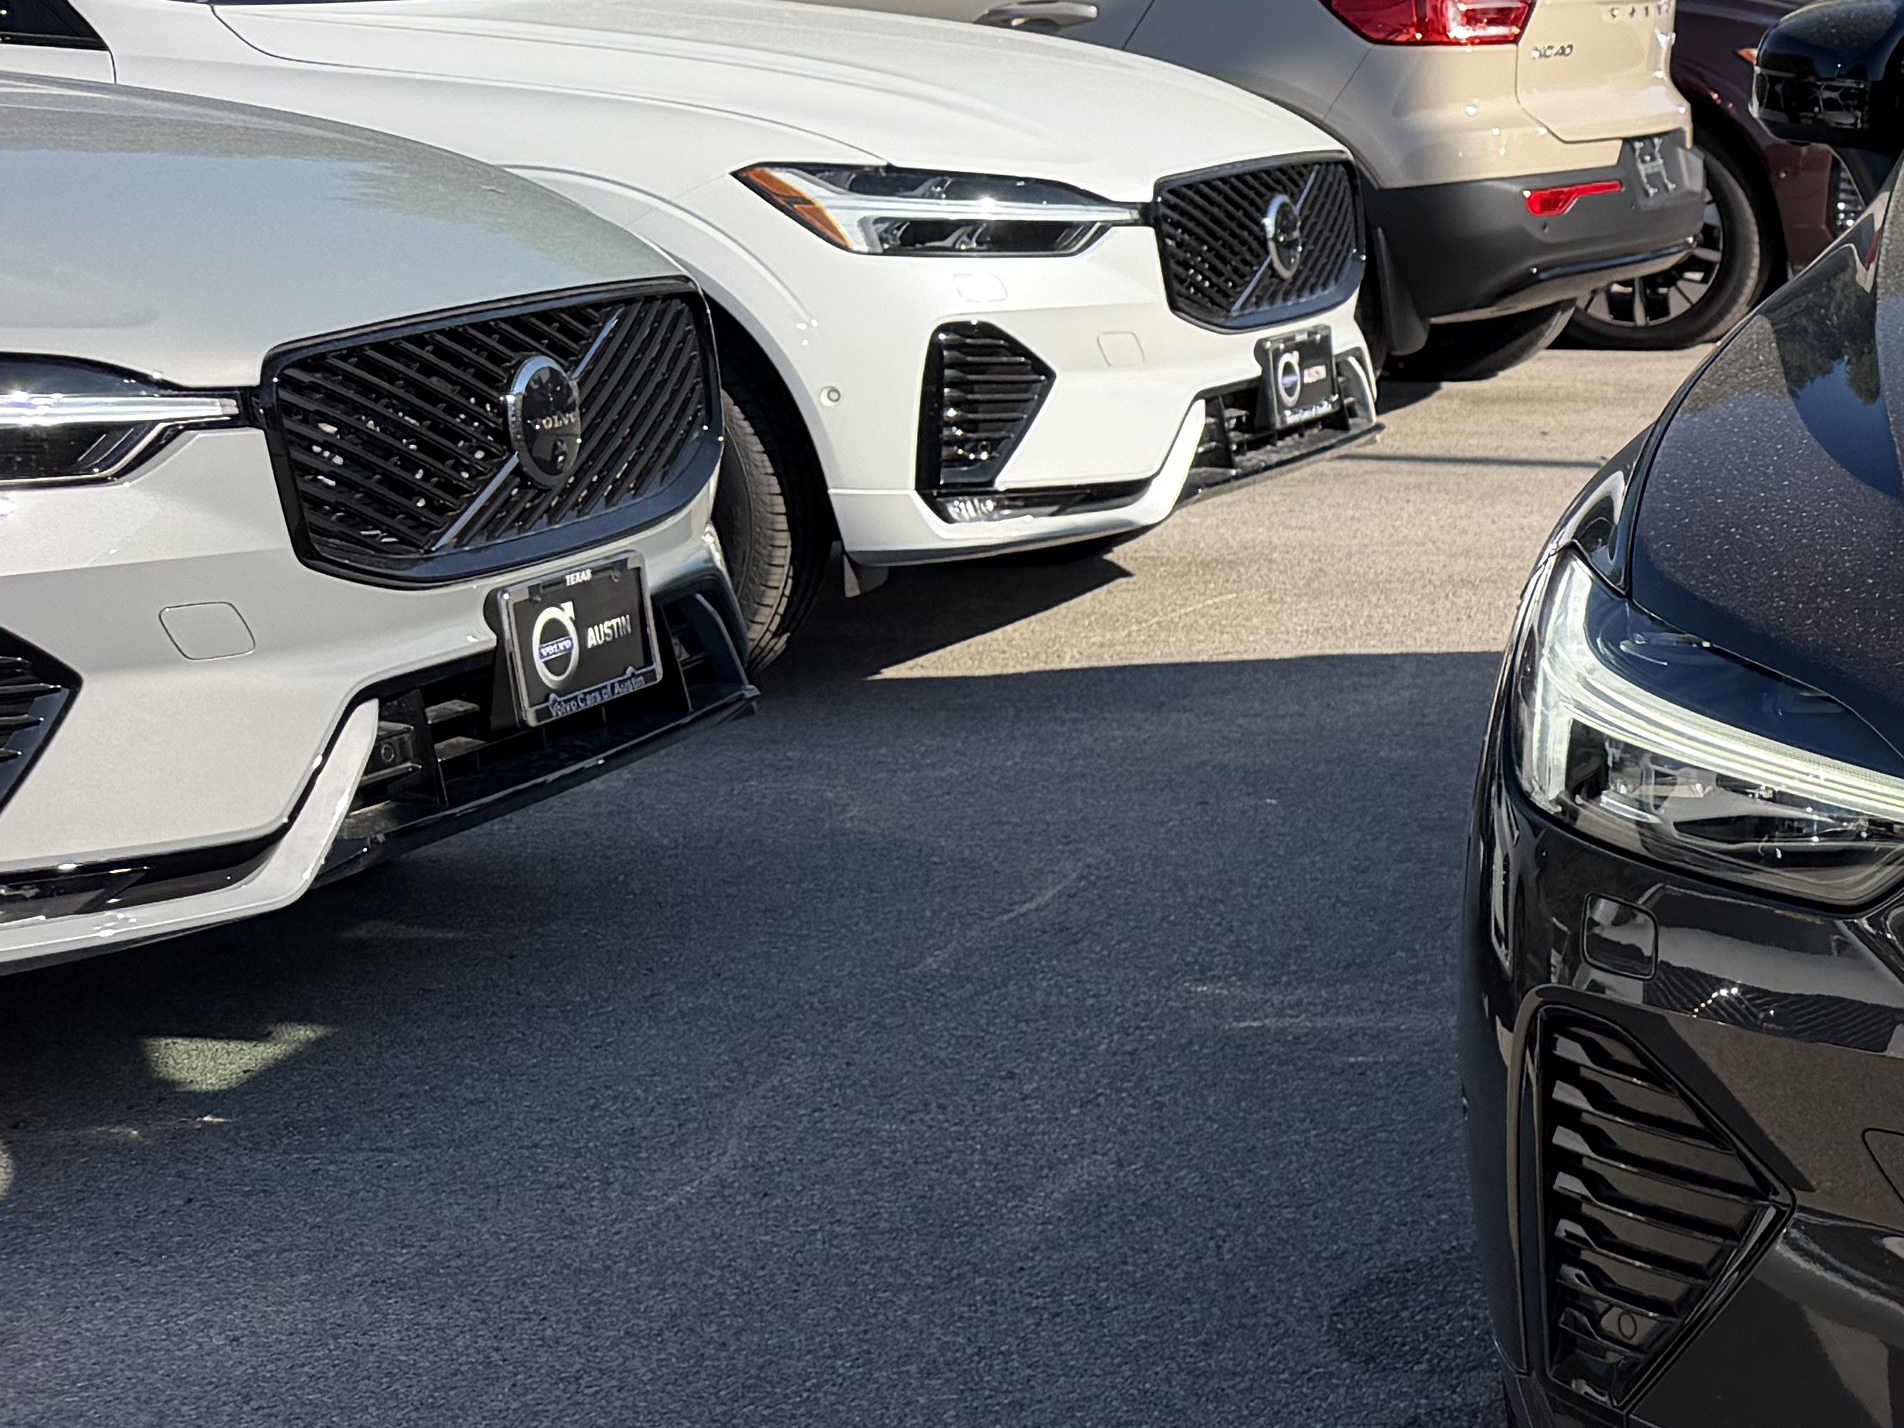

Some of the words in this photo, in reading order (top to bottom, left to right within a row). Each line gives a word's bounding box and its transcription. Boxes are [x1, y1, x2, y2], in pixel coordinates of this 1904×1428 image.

[565, 569, 593, 586] TEXAS
[587, 614, 632, 649] AUSTIN
[540, 639, 573, 657] VOLVO
